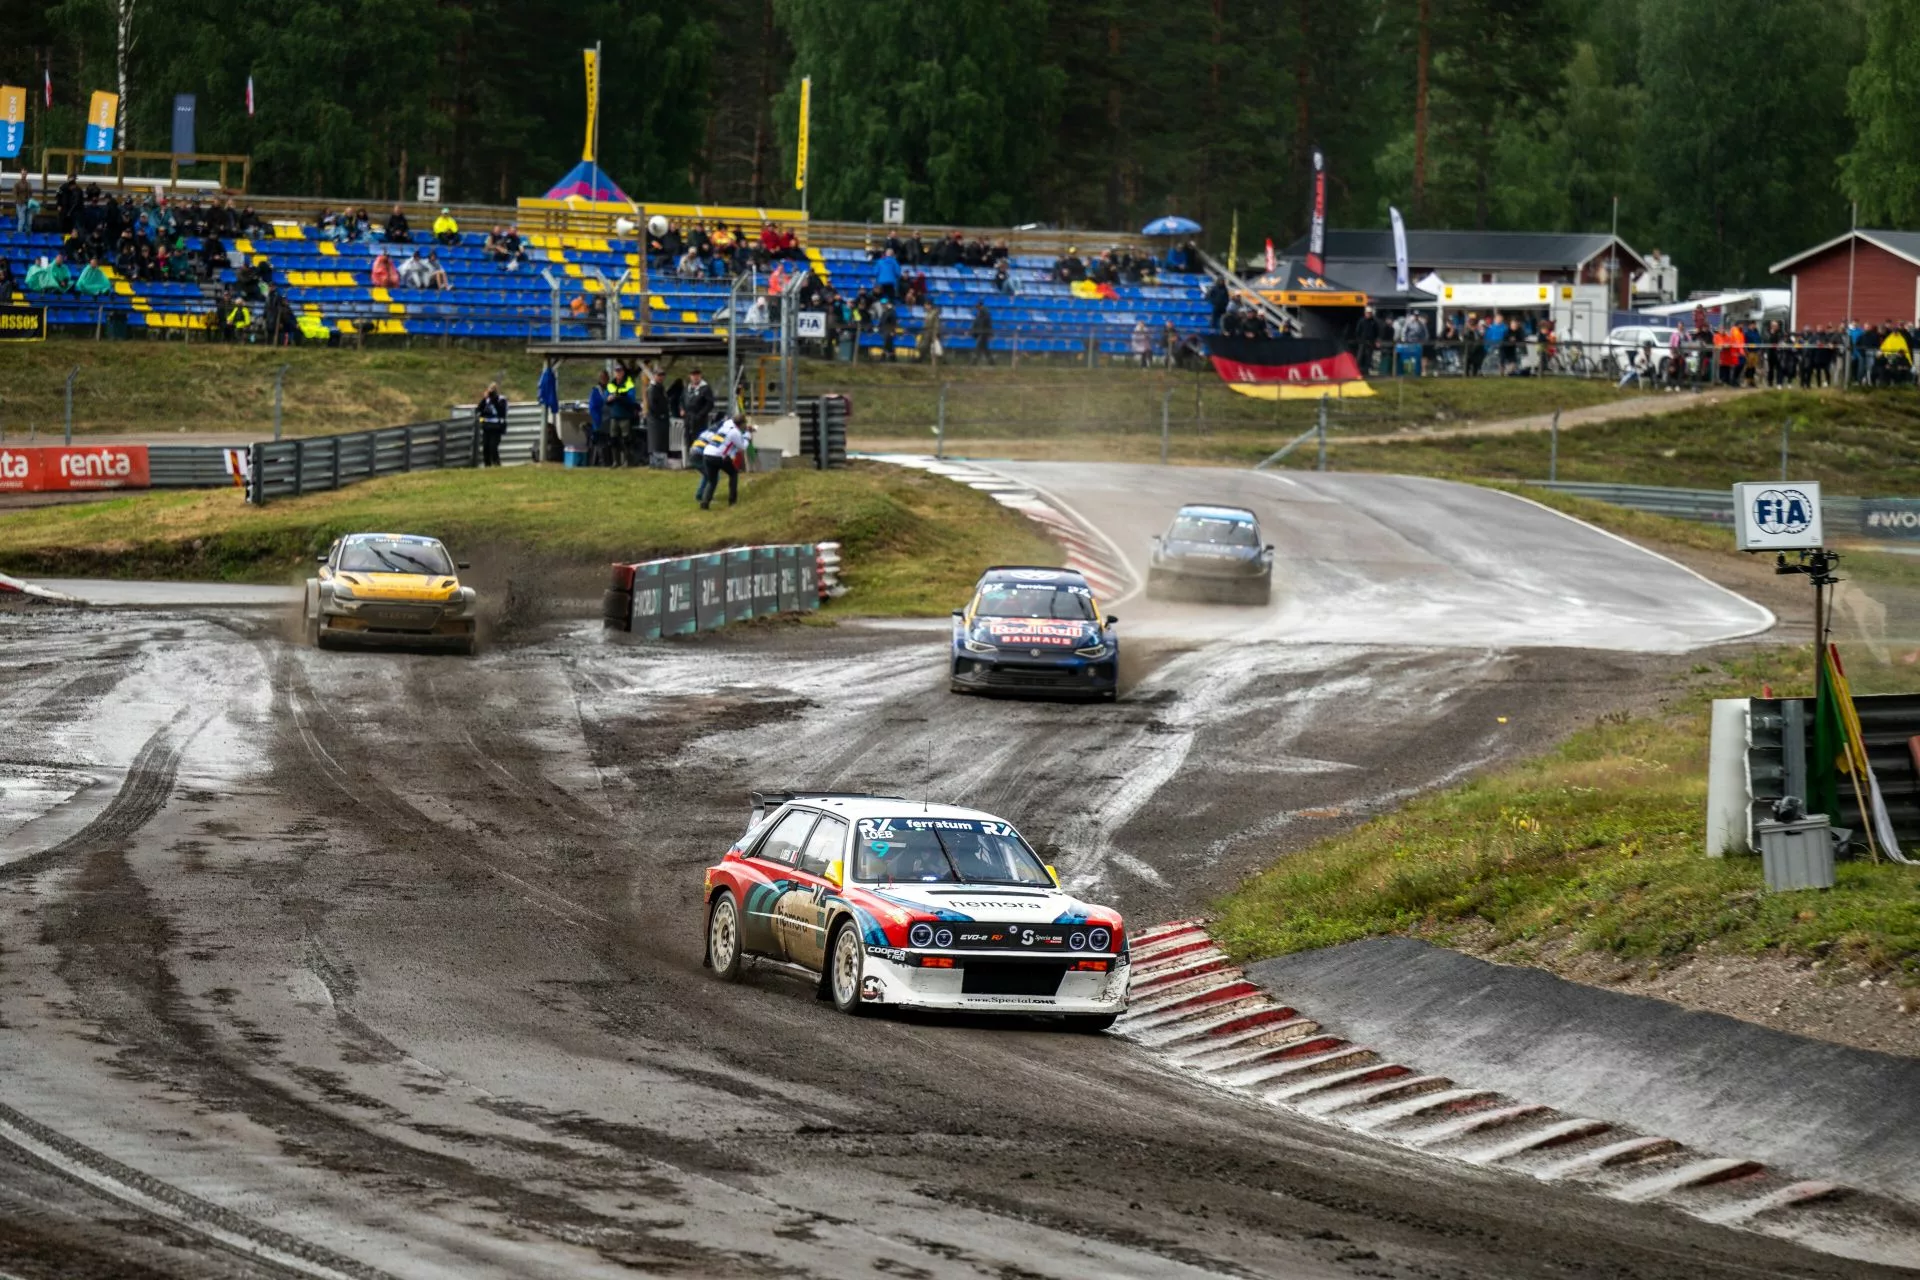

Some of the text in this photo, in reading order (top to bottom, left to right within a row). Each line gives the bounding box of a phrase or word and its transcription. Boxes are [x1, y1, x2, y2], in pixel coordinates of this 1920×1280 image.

[97, 101, 109, 151] WECON
[424, 178, 436, 197] E
[889, 201, 900, 219] F
[0, 314, 38, 329] RSSON
[0, 451, 28, 478] ta
[60, 449, 131, 477] renta
[1867, 511, 1920, 527] #WO
[990, 625, 1082, 637] Red Bull
[1002, 636, 1072, 645] BAUHAUS
[906, 820, 972, 830] ferratum
[863, 831, 894, 840] LOEB
[871, 842, 890, 858] 9
[949, 900, 1041, 909] hemora
[867, 946, 906, 957] COOPER
